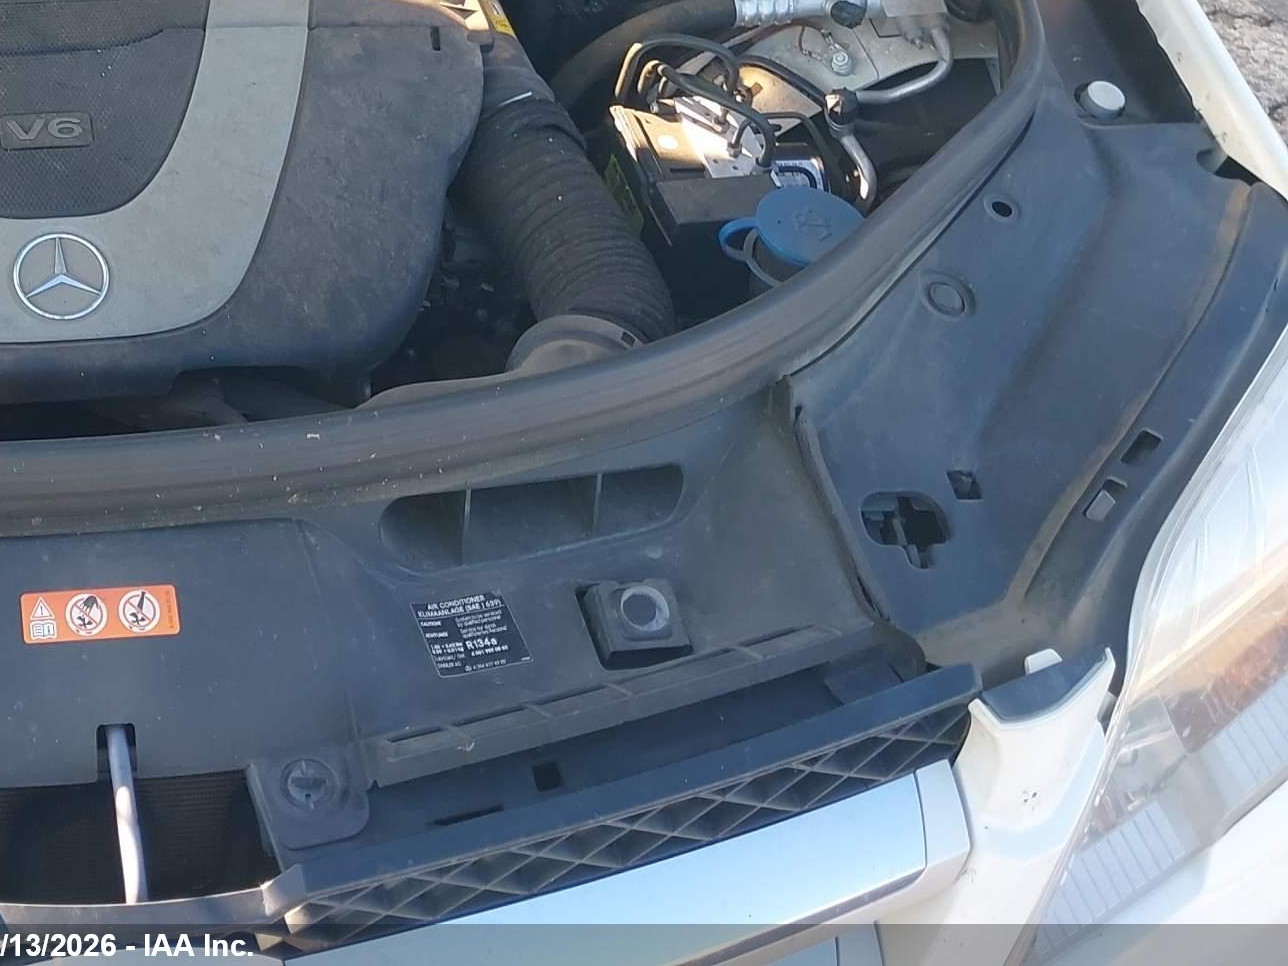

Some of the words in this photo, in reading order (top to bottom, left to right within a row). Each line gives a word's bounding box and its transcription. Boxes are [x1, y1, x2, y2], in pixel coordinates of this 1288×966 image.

[6, 117, 83, 141] V6
[427, 603, 439, 611] AIR
[439, 594, 485, 609] CONDITIONER
[417, 606, 464, 618] KLIMAANLAGE
[465, 636, 498, 650] R134a
